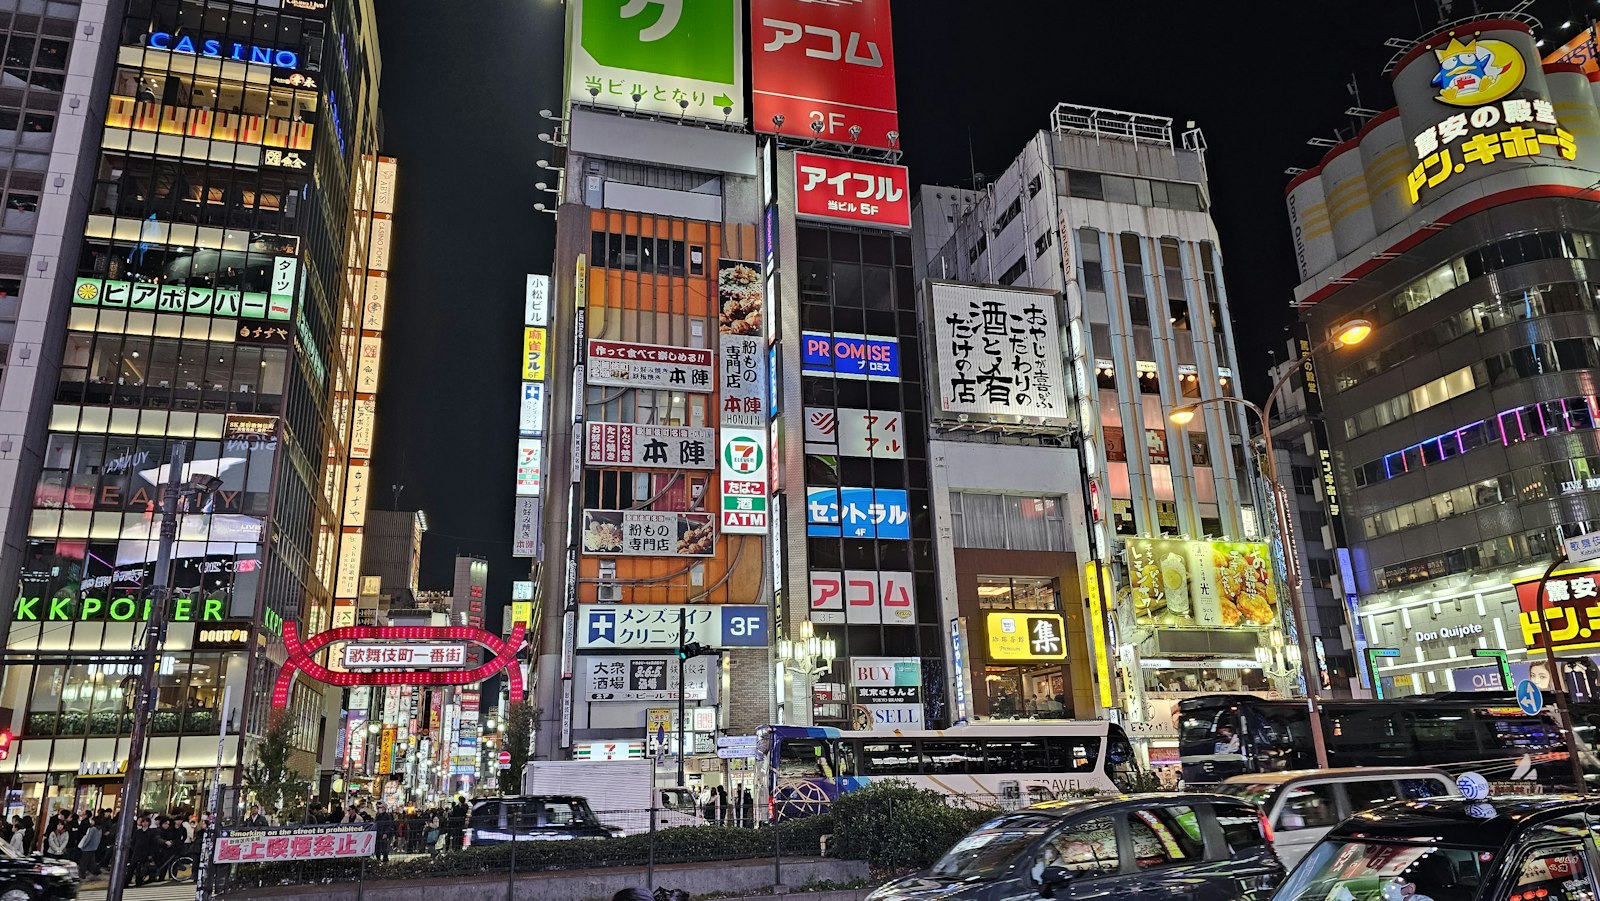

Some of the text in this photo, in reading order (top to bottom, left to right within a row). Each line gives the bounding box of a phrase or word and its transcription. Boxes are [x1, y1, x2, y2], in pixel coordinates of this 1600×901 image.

[150, 31, 298, 69] CASINO
[763, 17, 883, 68] アコム
[585, 75, 705, 107] 当ビルとなり
[808, 110, 847, 134] 3F
[1413, 98, 1557, 159] 驚安の殿堂
[800, 166, 903, 202] アイフル
[827, 200, 879, 215] 当ビル 5F
[1289, 194, 1298, 223] Don
[277, 260, 293, 290] ダーツ
[104, 285, 263, 312] ビアポンバー
[531, 278, 544, 322] 小松ビル
[528, 329, 542, 371] 麻雀ブル
[742, 340, 757, 383] 粉もの
[808, 339, 891, 362] PROMISE
[945, 313, 977, 403] だけの店
[968, 301, 1013, 406] 酒と肴
[1008, 314, 1032, 406] こだわりの
[1023, 303, 1053, 409] おやじが喜ぶ
[669, 367, 709, 385] 本陣
[726, 346, 741, 389] 専門店
[857, 360, 891, 372] プロミス
[724, 395, 761, 413] 本陣
[726, 415, 760, 426] HONJIN
[643, 438, 706, 465] 本陣
[727, 482, 761, 494] たばこ
[1561, 481, 1583, 492] LIVE
[736, 498, 753, 510] 酒
[809, 500, 908, 525] セントラル
[522, 500, 532, 539] お好み焼き
[628, 524, 669, 537] 粉もの
[726, 514, 764, 527] ATM
[855, 528, 866, 536] 4F
[628, 538, 670, 551] 専門店
[812, 579, 910, 607] アコム
[1544, 576, 1598, 602] 驚安
[467, 586, 483, 663] HUMX
[619, 607, 713, 625] メンズライフ
[730, 617, 760, 636] 3F
[820, 613, 834, 622] 3F
[200, 630, 248, 642] DOUTOR
[619, 628, 695, 645] クリニック
[1031, 619, 1060, 653] 集
[1416, 623, 1483, 642] Don Quijote
[349, 648, 461, 663] 歌舞伎町一番街
[593, 662, 625, 675] 大衆
[857, 666, 892, 680] BUY
[593, 677, 625, 690] 酒場
[875, 709, 919, 723] SELL
[293, 827, 315, 835] street
[326, 825, 364, 833] prohibited.
